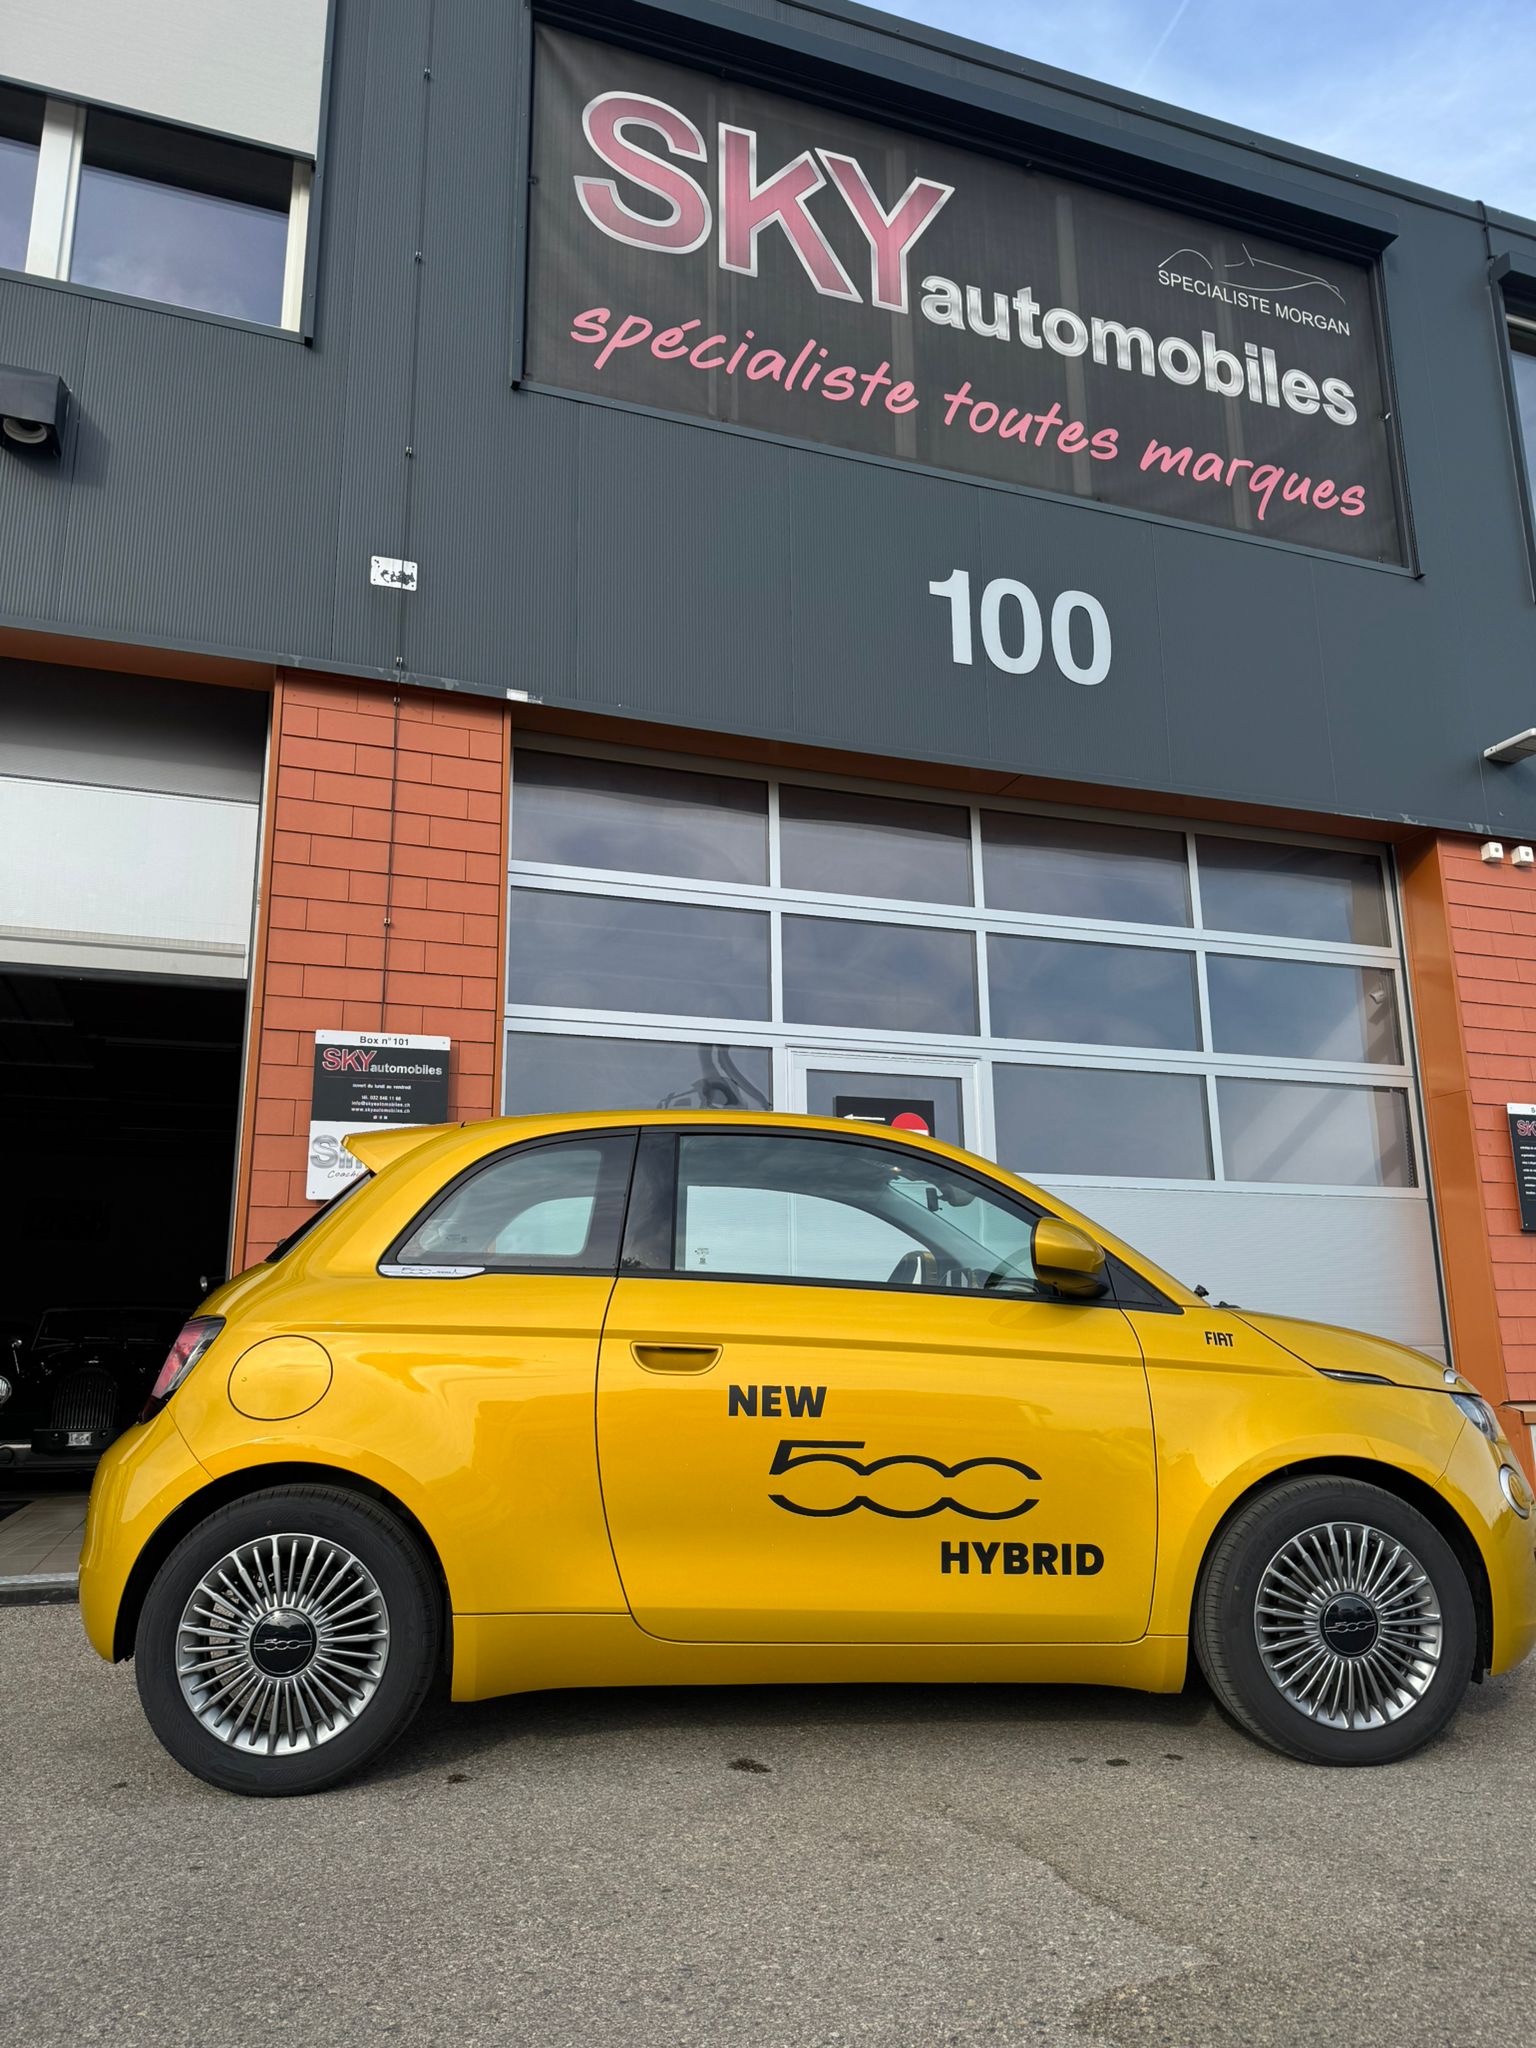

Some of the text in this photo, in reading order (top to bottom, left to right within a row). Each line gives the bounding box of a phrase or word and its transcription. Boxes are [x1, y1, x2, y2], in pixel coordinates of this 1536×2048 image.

[573, 91, 1358, 426] SKY automobiles
[1158, 270, 1350, 336] SPECIALISTE MORGAN
[570, 307, 1366, 520] spécialiste toutes marques
[929, 568, 1112, 686] 100
[322, 1048, 443, 1076] SKY automobiles
[360, 1035, 379, 1045] Box
[1204, 1331, 1233, 1347] FIAT
[728, 1385, 827, 1418] NEW
[767, 1440, 1043, 1521] 500
[941, 1541, 1105, 1576] HYBRID
